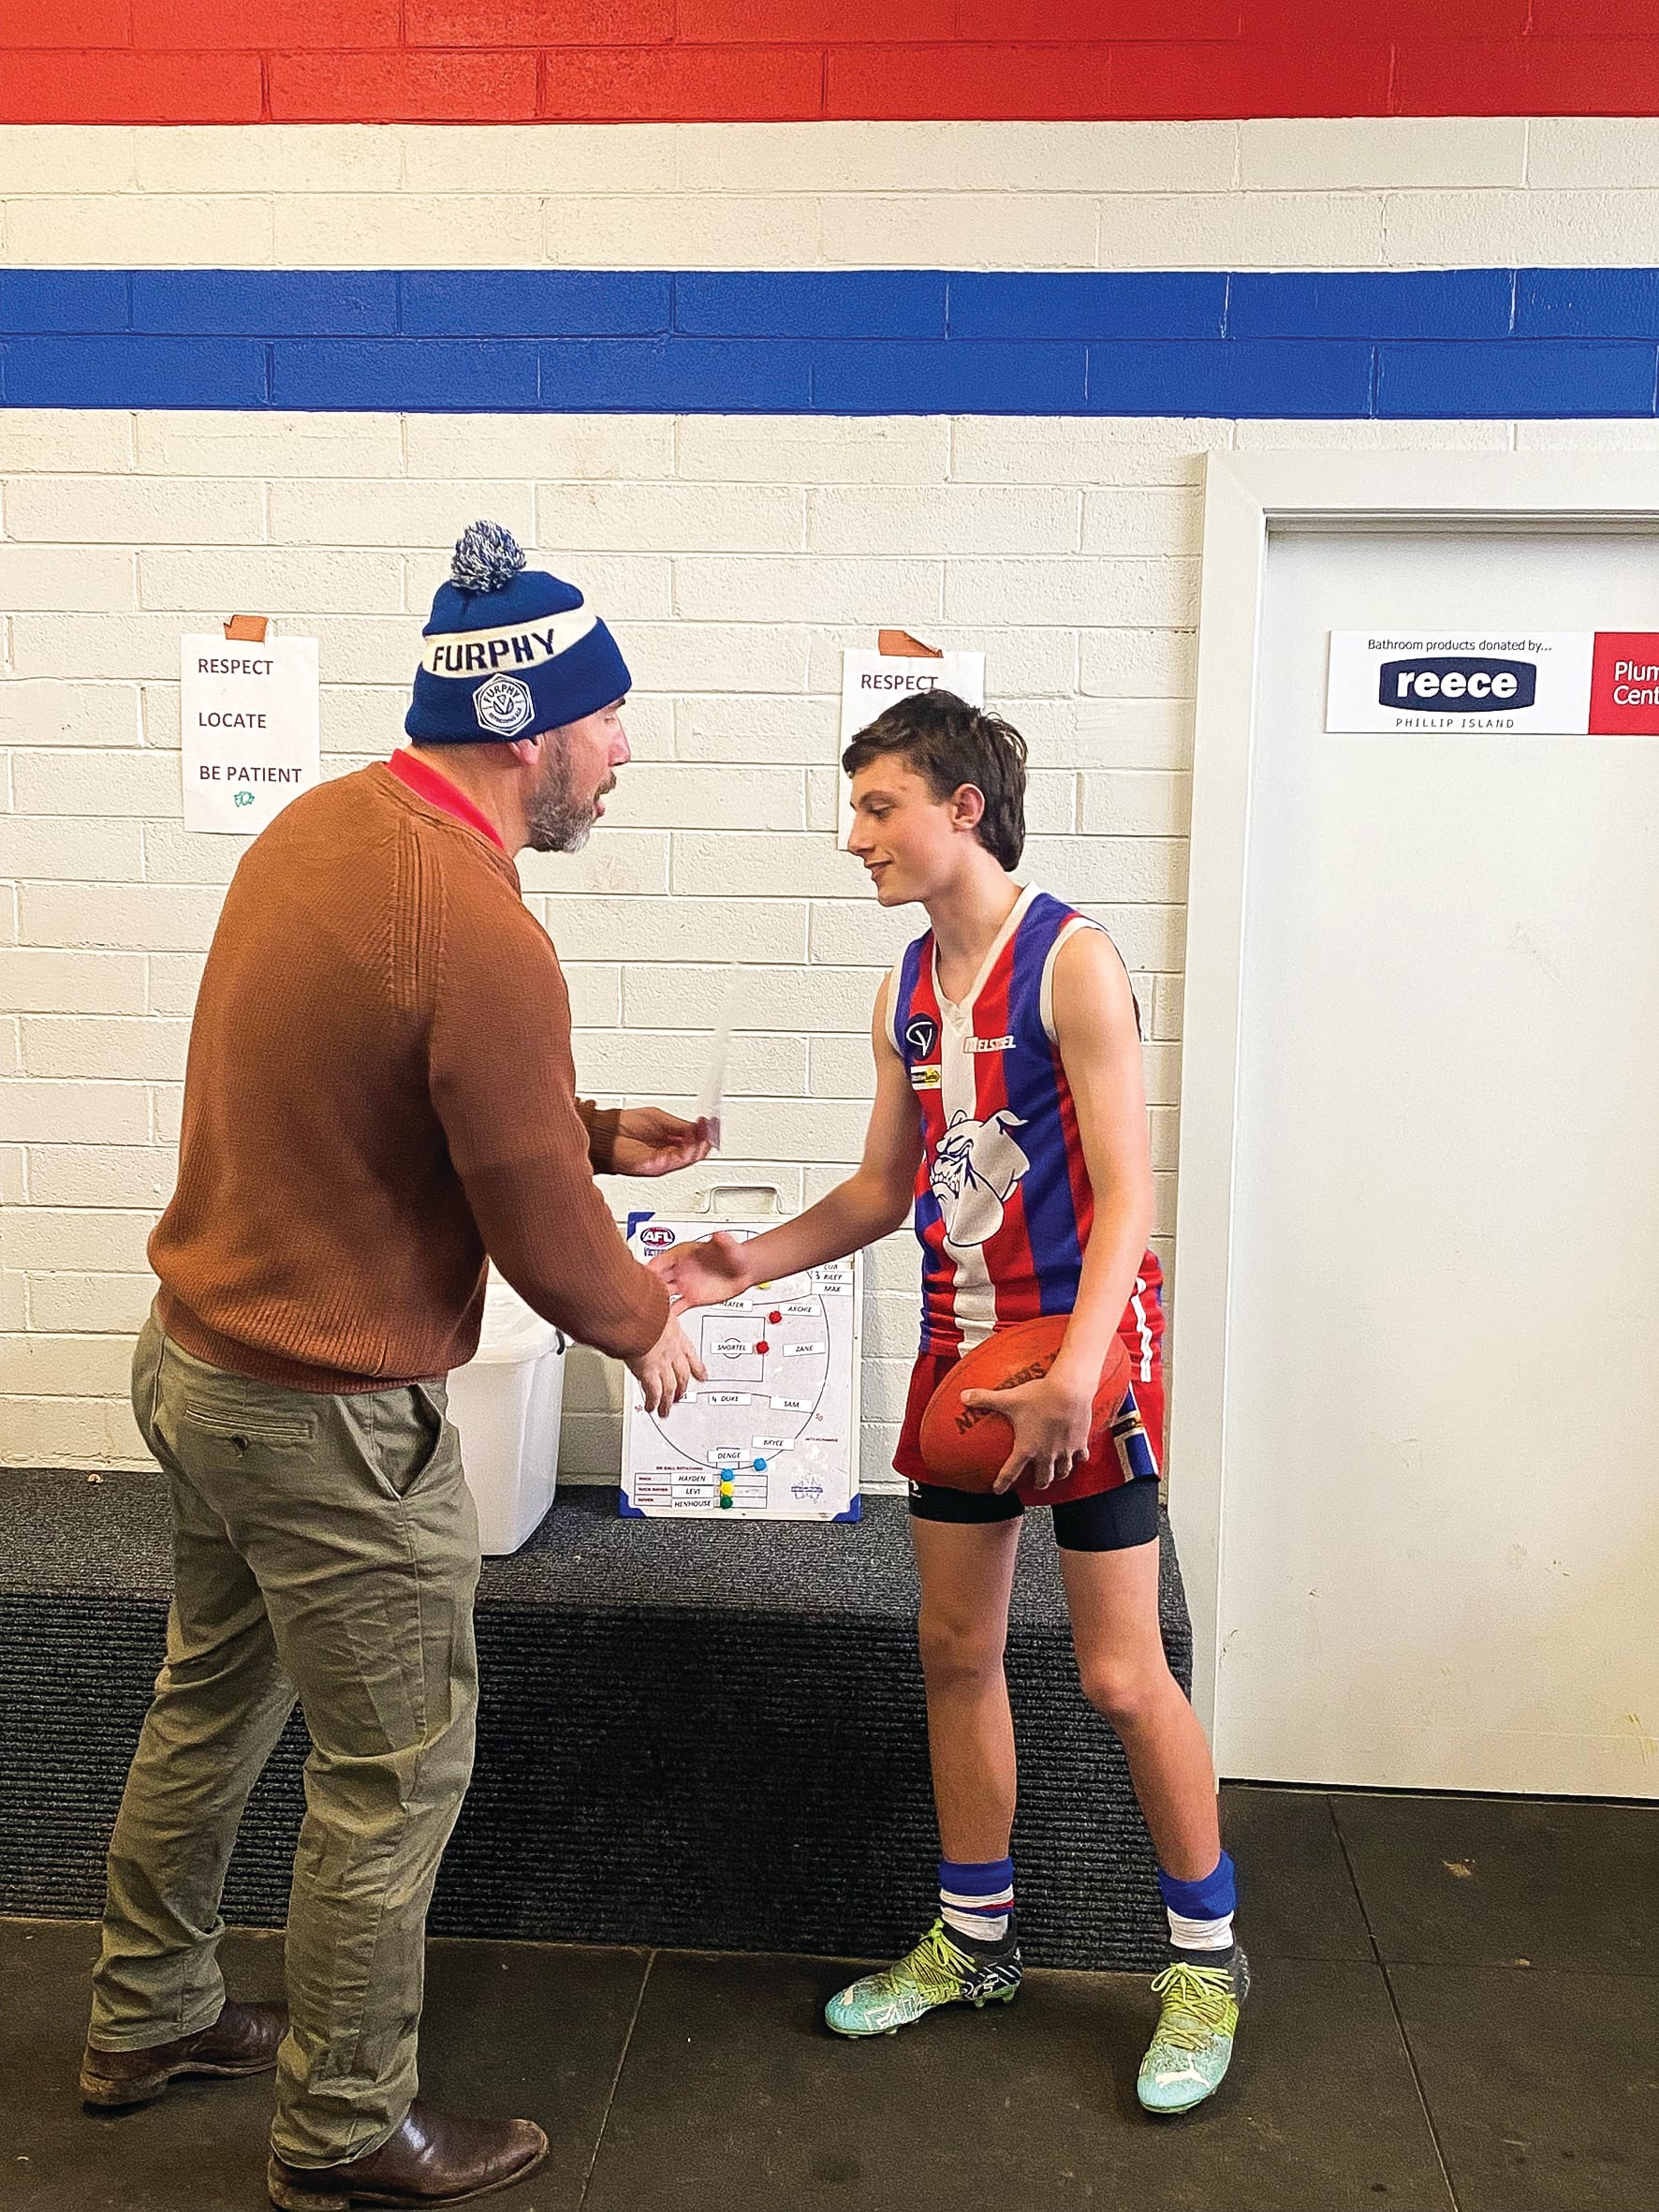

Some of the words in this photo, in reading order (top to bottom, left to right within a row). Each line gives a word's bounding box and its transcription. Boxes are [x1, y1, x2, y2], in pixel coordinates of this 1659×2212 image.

[433, 628, 554, 671] FURPHY
[1368, 639, 1423, 651] Bathroom
[1426, 640, 1475, 653] products
[1478, 640, 1525, 652] donated
[198, 658, 274, 675] RESPECT
[860, 673, 939, 691] RESPECT
[1397, 671, 1518, 699] reece
[483, 684, 521, 703] FURPHY
[198, 712, 267, 729] LOCATE
[1396, 717, 1454, 728] PHILLIP
[1461, 718, 1515, 729] ISLAND
[199, 765, 221, 780] BE
[227, 766, 302, 783] PATIENT
[643, 1231, 672, 1243] AFL
[719, 1300, 744, 1308] EATER
[815, 1412, 824, 1422] 50
[717, 1452, 741, 1460] DENGE
[674, 1498, 712, 1509] HENHOUSE
